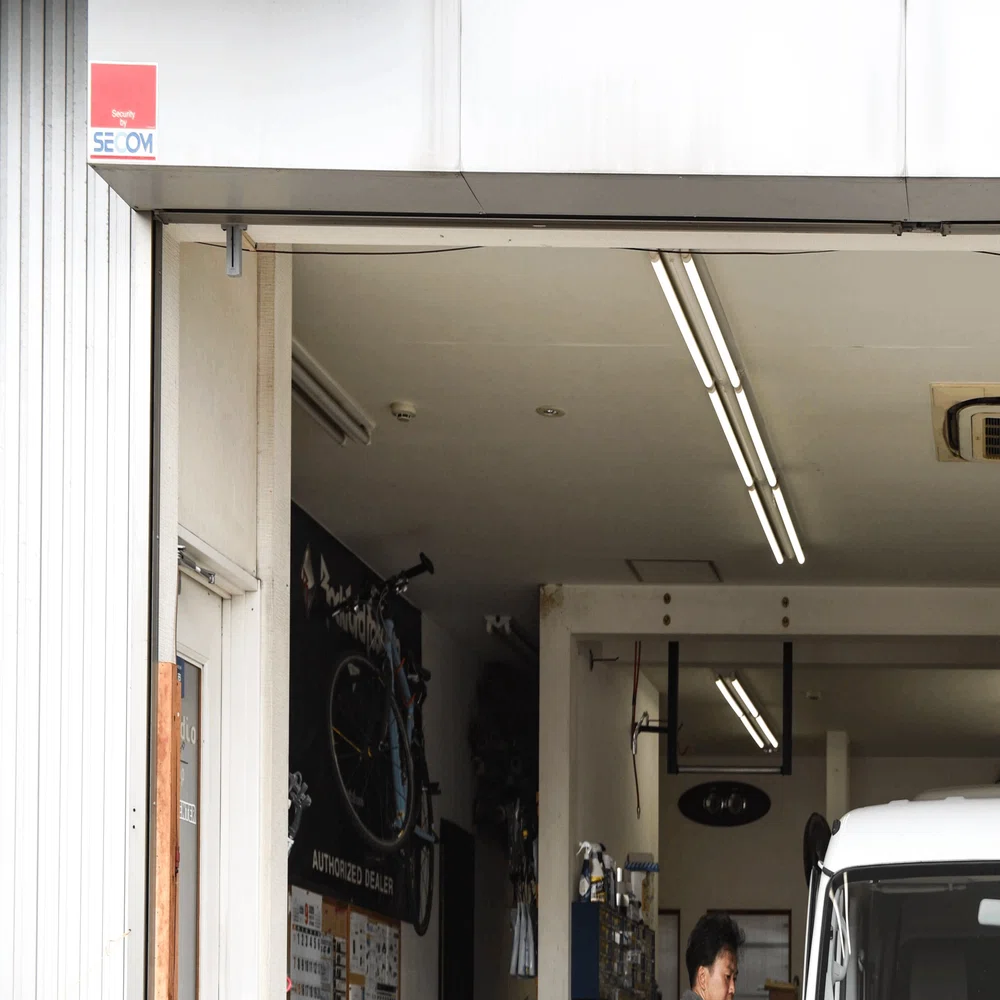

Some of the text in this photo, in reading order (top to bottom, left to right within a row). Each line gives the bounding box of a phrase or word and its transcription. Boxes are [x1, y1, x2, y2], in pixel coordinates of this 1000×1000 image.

[112, 109, 135, 120] Security
[120, 119, 127, 128] by
[94, 132, 153, 153] SECOM
[312, 849, 394, 896] AUTHORIZED DEALER
